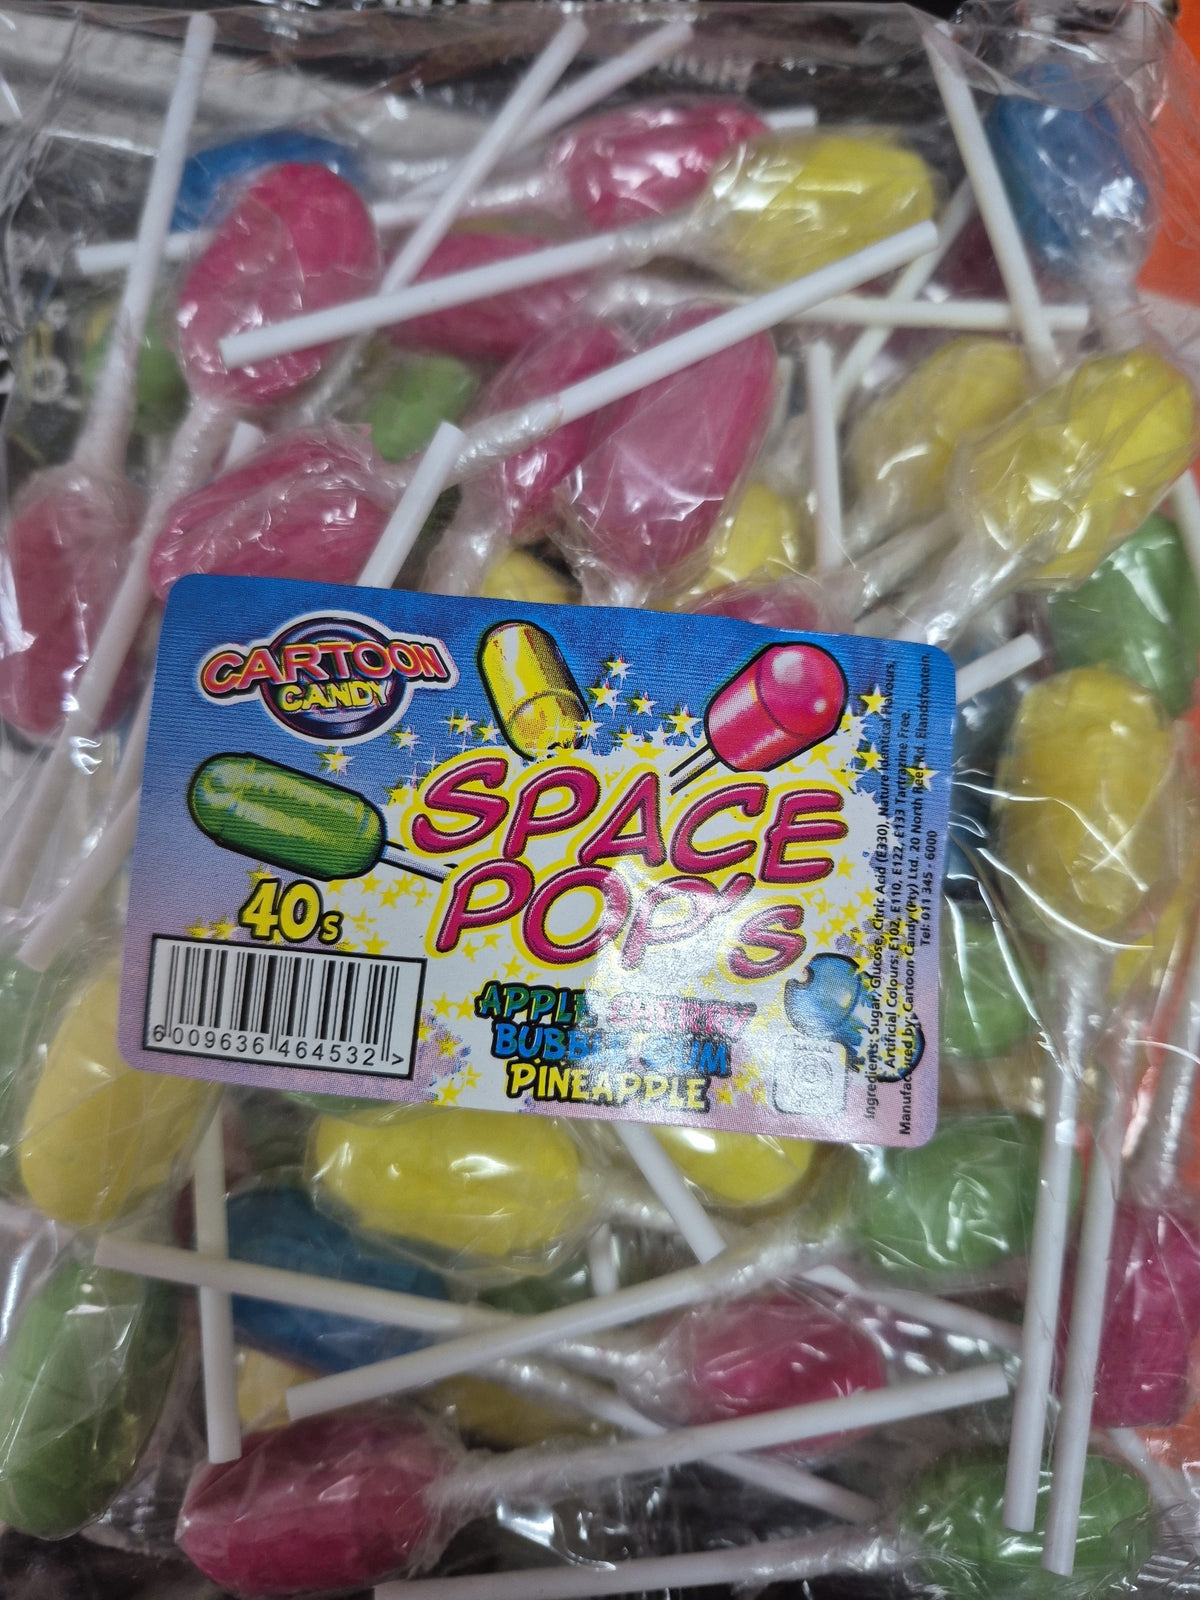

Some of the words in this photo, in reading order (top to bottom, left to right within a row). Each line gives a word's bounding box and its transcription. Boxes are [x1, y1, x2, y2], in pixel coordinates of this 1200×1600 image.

[202, 640, 449, 694] CARTOON
[280, 680, 388, 713] CANDY
[880, 660, 897, 715] Flavours,
[878, 718, 892, 771] Identical
[913, 743, 926, 763] Rd.
[894, 743, 908, 805] Tartrazine
[912, 767, 924, 794] Reef
[877, 775, 890, 817] Nature
[413, 757, 849, 883] SPACE
[894, 809, 905, 838] E133
[911, 798, 923, 834] North
[875, 821, 890, 863] (E330),
[892, 842, 905, 875] E122,
[909, 837, 920, 853] 20
[924, 830, 937, 860] 6000
[874, 866, 886, 894] Acid
[907, 856, 919, 880] Ltd.
[922, 872, 934, 894] 345
[238, 878, 344, 944] 40s
[873, 898, 885, 931] Citric
[890, 880, 903, 913] E110,
[906, 883, 920, 913] (Pty)
[920, 899, 931, 921] 011
[434, 857, 807, 979] POP'S
[888, 917, 901, 951] E102,
[904, 917, 919, 956] Candy
[919, 924, 931, 946] Tel:
[870, 935, 884, 989] Glucose,
[886, 955, 899, 1008] Colours:
[902, 960, 915, 1013] Cartoon
[867, 993, 882, 1035] Sugar,
[901, 1018, 916, 1036] by:
[640, 1036, 728, 1076] GUM
[885, 1012, 897, 1069] Artificial
[509, 1062, 706, 1110] PINEAPPLE
[863, 1039, 879, 1119] Ingredients:
[899, 1041, 913, 1135] Manufacured
